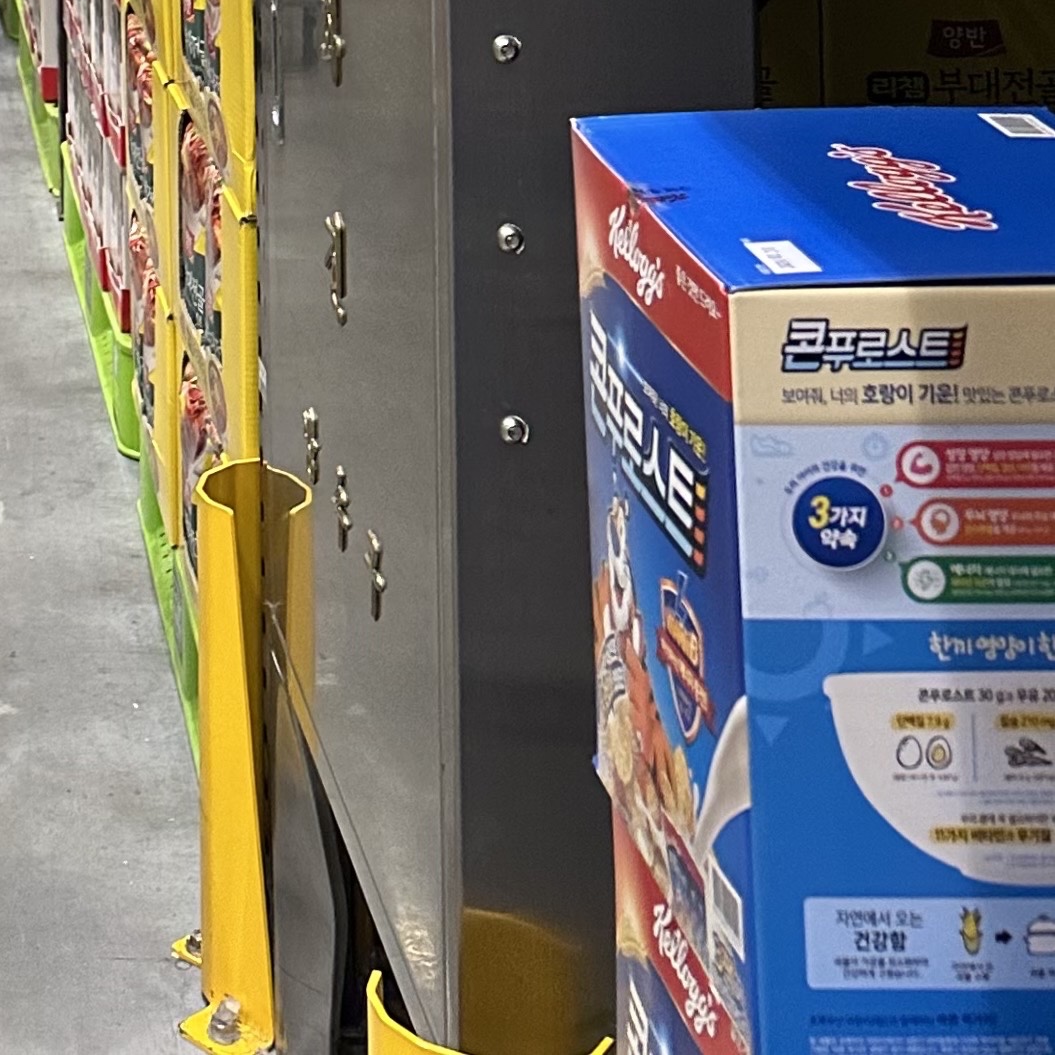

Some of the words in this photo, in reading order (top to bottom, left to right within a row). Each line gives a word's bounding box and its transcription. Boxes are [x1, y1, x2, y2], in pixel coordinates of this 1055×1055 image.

[944, 26, 987, 49] 양반
[872, 76, 926, 100] 리챔
[608, 204, 666, 306] Kellogg's
[781, 318, 952, 372] 콘푸로스트
[781, 386, 828, 406] 보여줘,
[862, 383, 914, 405] 호랑이
[918, 383, 959, 405] 기운!
[588, 307, 697, 560] 콘푸로스트
[807, 494, 868, 529] 3가지
[819, 529, 858, 550] 약속
[835, 908, 891, 928] 자연에서
[895, 908, 925, 929] 오는
[853, 930, 908, 953] 건강함
[652, 903, 718, 1039] Kellogg's
